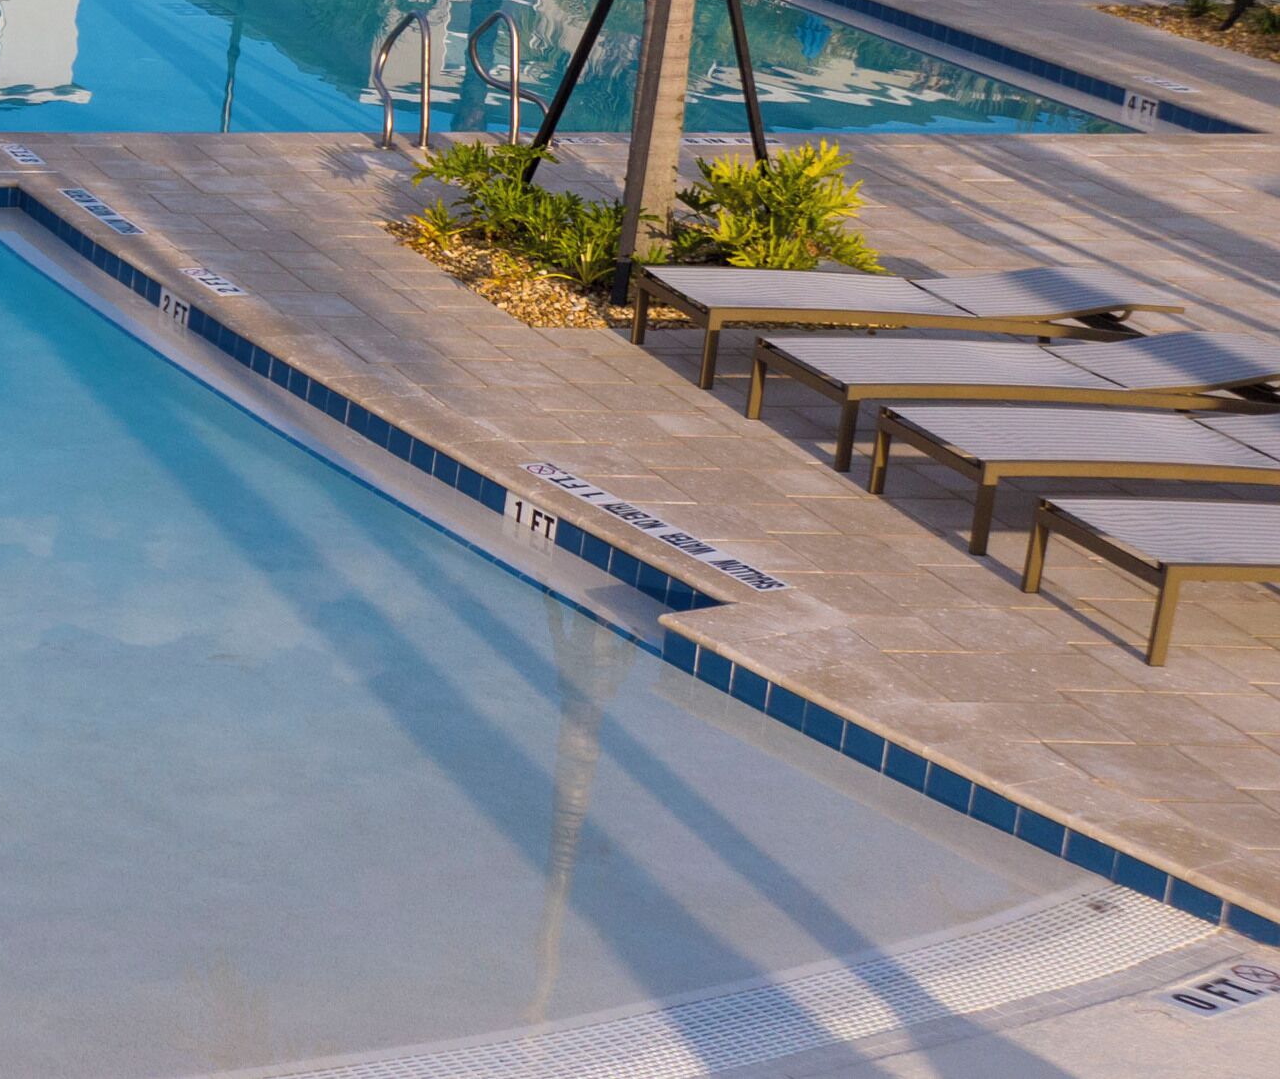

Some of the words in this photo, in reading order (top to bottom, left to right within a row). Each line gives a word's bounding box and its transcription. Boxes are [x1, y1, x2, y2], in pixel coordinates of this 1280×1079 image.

[1128, 95, 1137, 110] 4
[1141, 99, 1157, 116] FT
[162, 294, 171, 314] 2
[173, 301, 188, 325] FT
[515, 501, 522, 523] 1
[531, 509, 555, 539] FT
[598, 502, 652, 521] ENTRY
[631, 520, 669, 530] NO
[658, 532, 717, 556] WATER
[708, 559, 786, 590] SHALLOW
[1171, 993, 1218, 1010] 0
